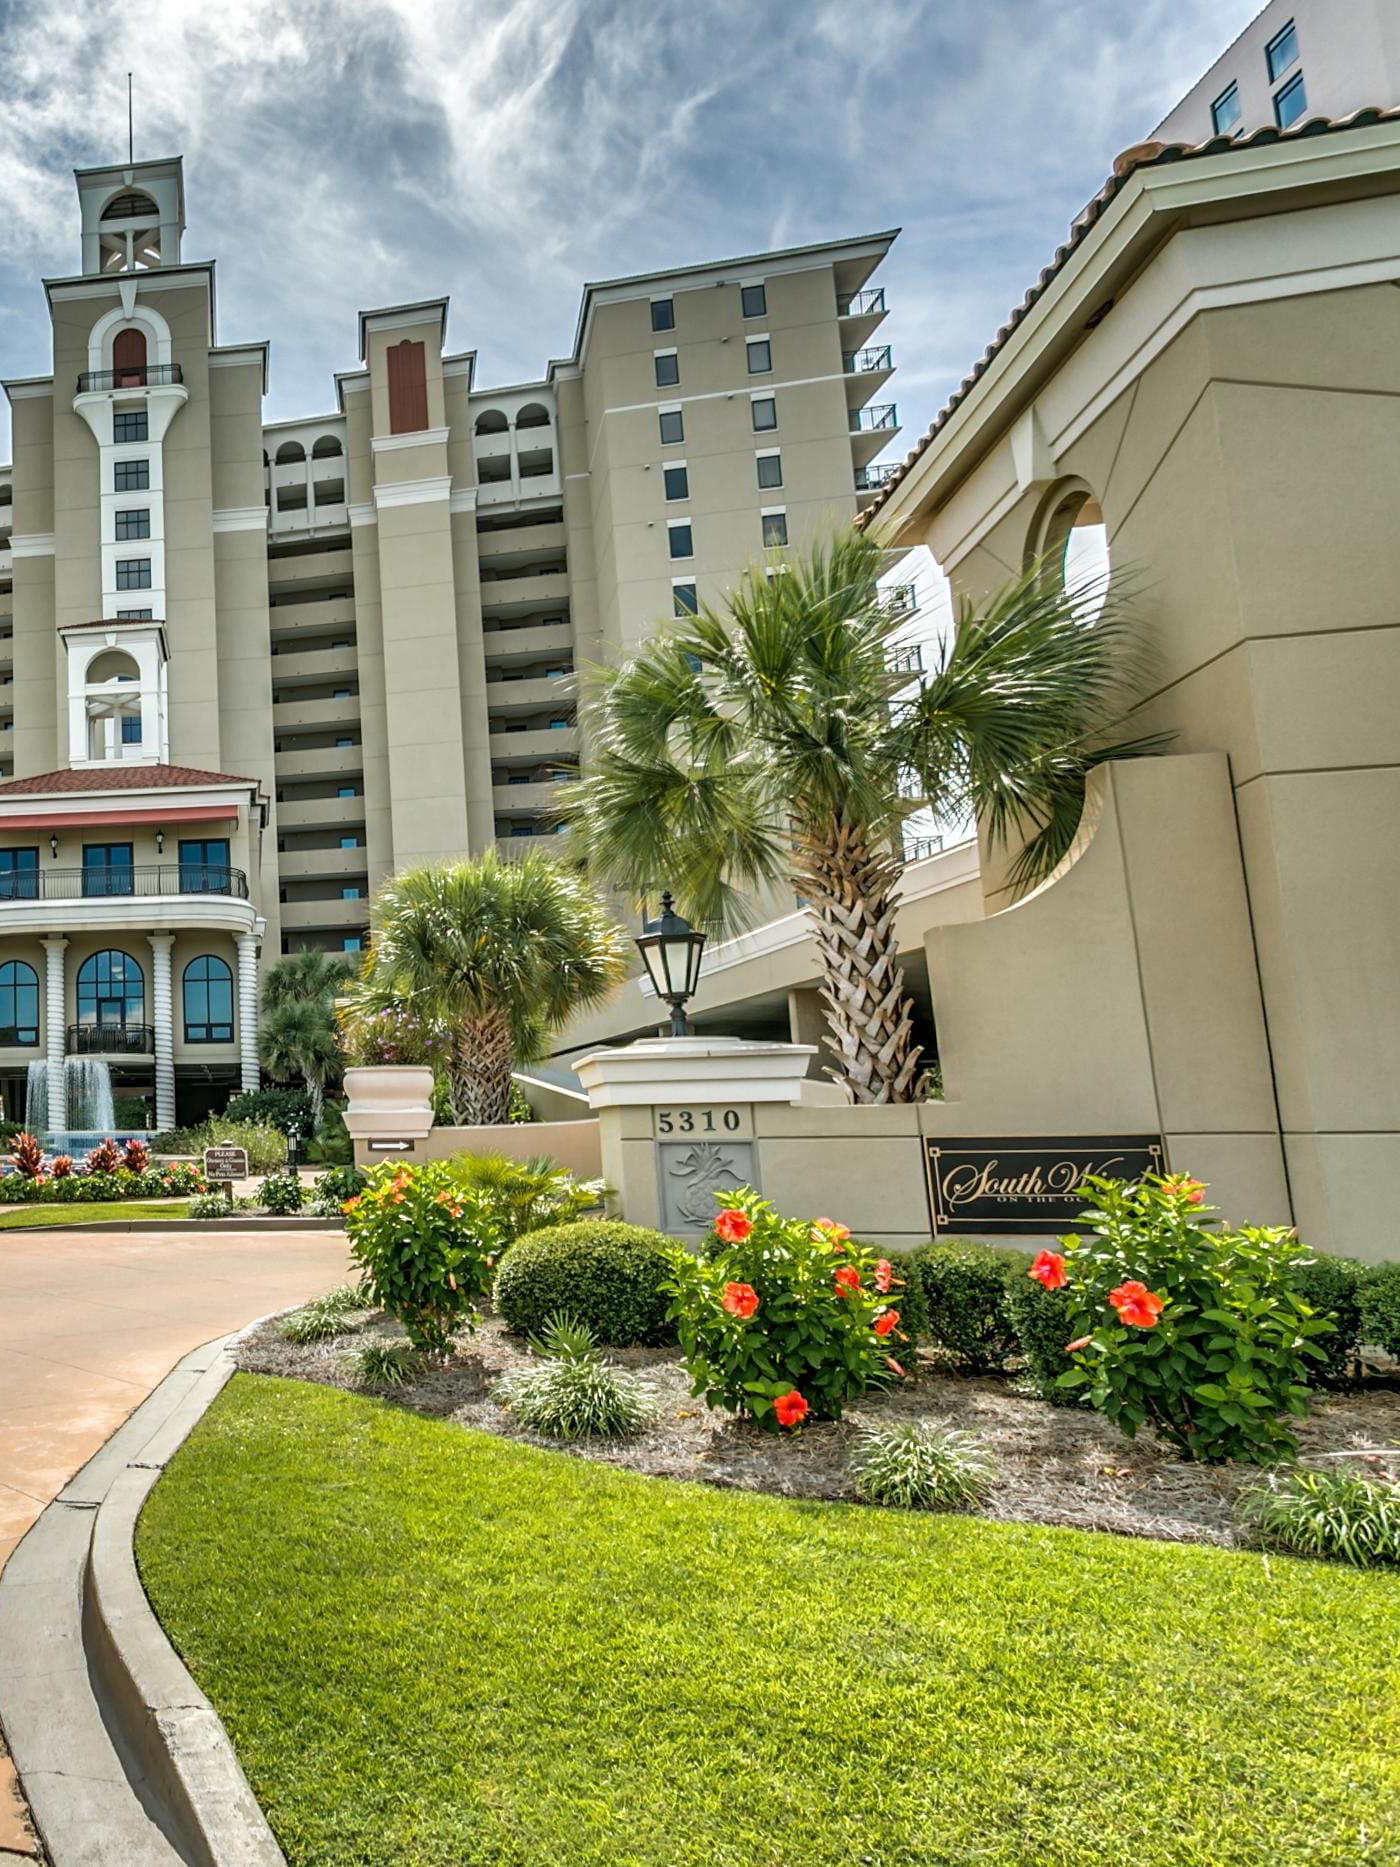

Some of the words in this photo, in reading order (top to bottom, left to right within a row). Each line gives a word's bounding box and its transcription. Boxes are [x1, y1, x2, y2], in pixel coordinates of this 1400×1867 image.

[659, 1110, 740, 1133] 5310
[943, 1159, 1048, 1213] South
[1048, 1157, 1154, 1193] Wid
